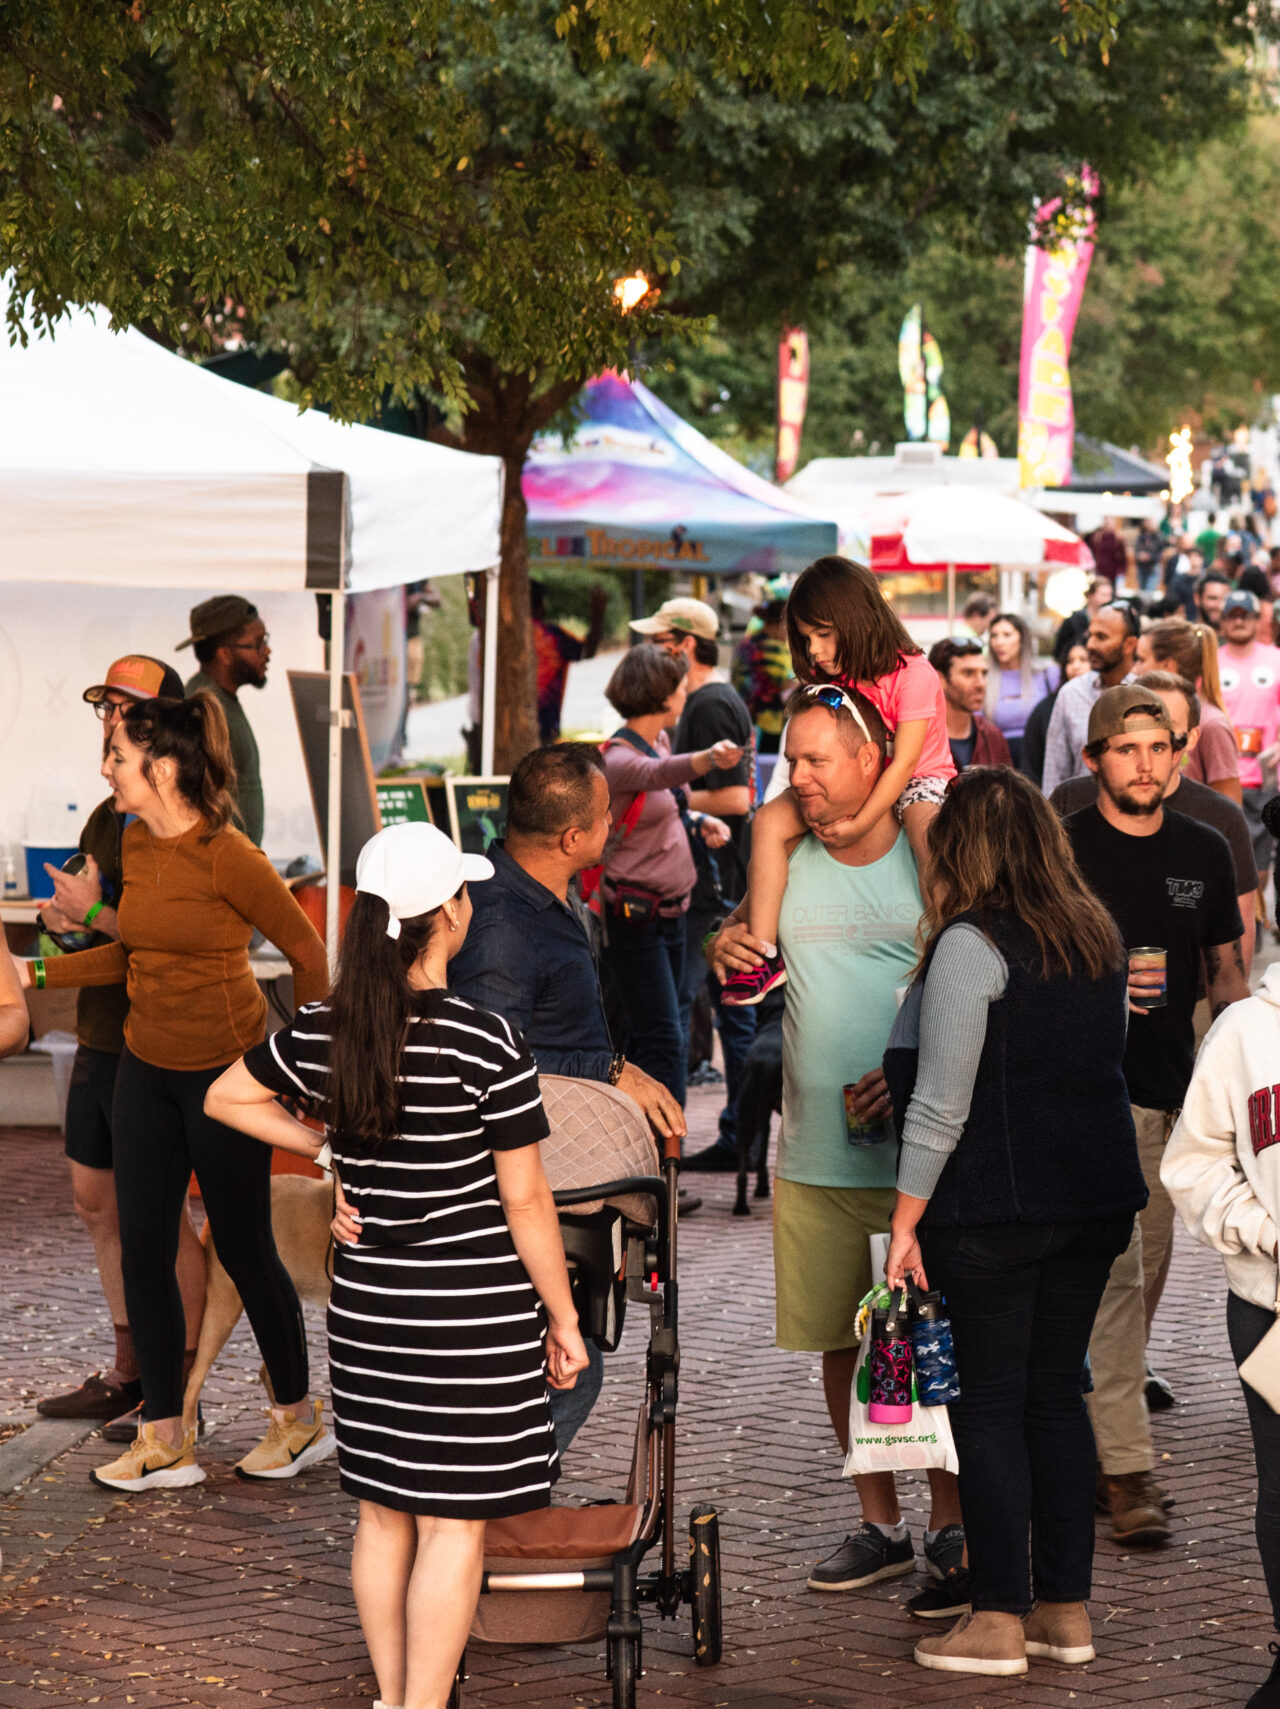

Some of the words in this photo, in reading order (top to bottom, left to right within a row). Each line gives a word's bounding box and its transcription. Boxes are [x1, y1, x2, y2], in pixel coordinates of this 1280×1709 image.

[586, 528, 710, 563] TROPICAL
[792, 904, 849, 924] OUTER
[853, 902, 916, 922] BANKS
[855, 1431, 938, 1447] www.gsvsc.org
